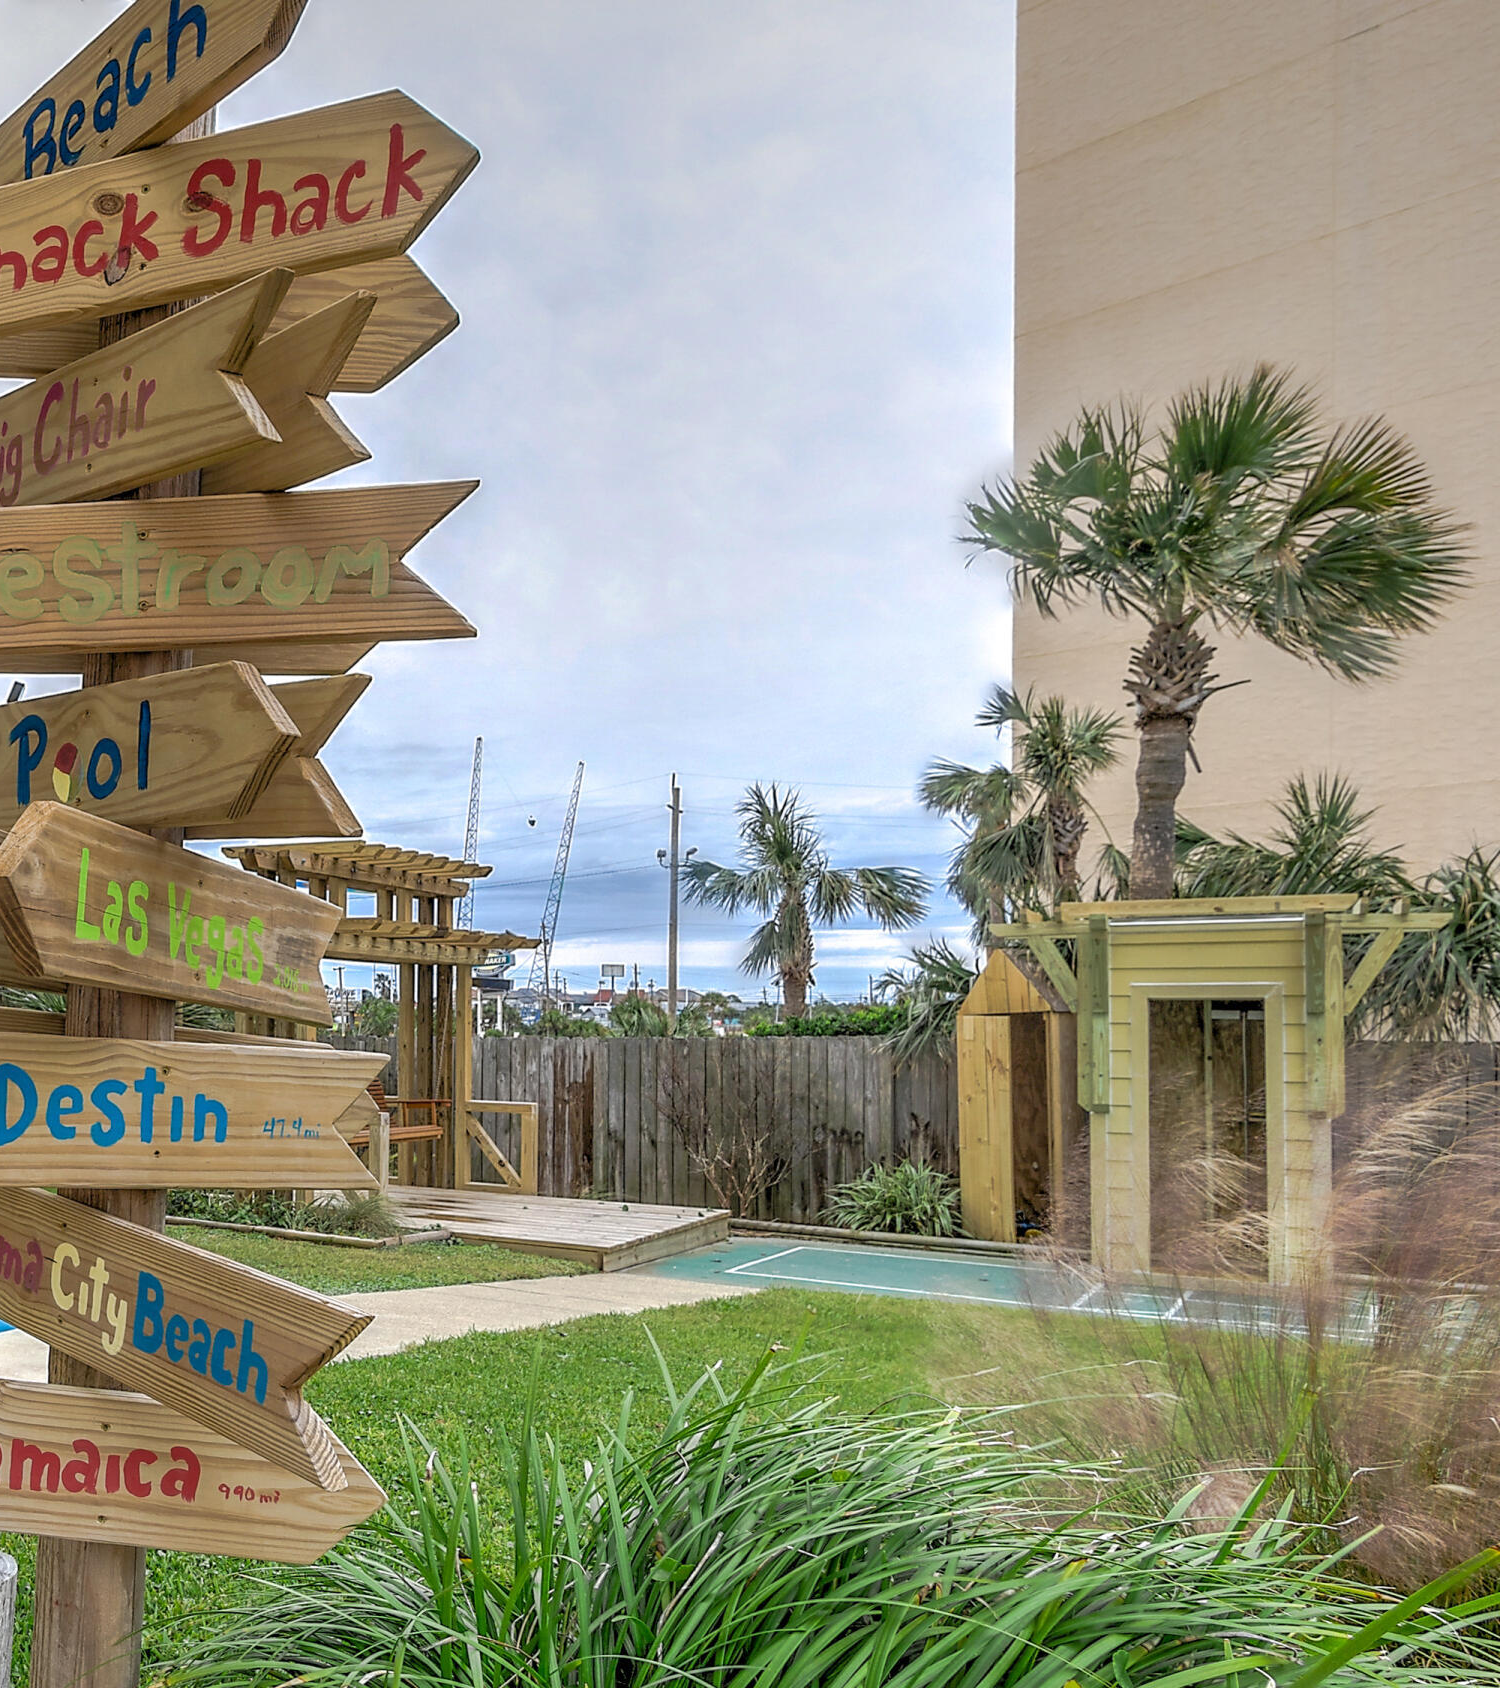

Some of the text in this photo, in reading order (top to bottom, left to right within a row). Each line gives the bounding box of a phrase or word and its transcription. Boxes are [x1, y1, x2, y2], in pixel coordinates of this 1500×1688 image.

[24, 0, 208, 179] Beach
[180, 123, 428, 258] Shack
[32, 366, 157, 475] Chair
[75, 847, 265, 990] Las Vegas
[263, 1116, 321, 1139] 47.4 mi
[49, 1241, 129, 1356] City
[132, 1271, 270, 1405] Beach
[218, 1483, 256, 1502] 990
